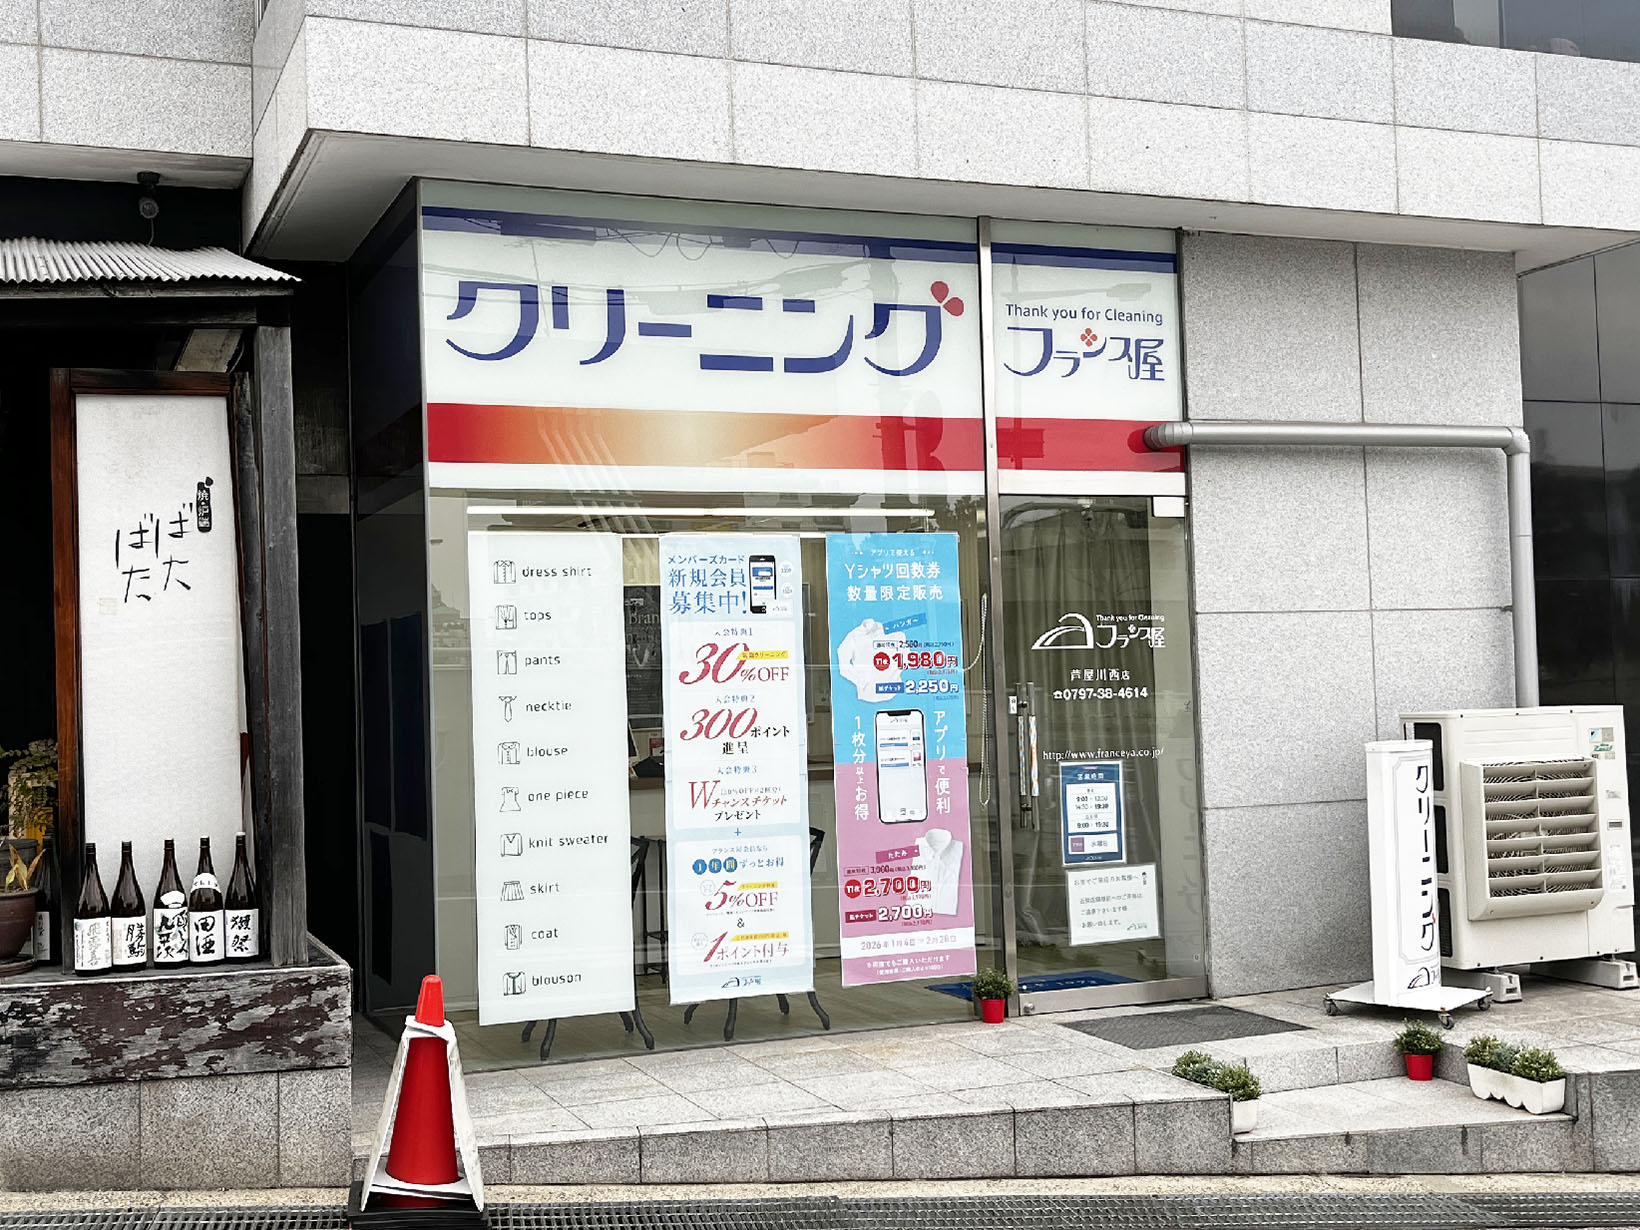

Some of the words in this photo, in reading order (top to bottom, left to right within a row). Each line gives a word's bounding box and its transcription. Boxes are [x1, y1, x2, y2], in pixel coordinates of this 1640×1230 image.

[1005, 304, 1048, 318] Thank
[1052, 308, 1077, 321] you
[1081, 307, 1100, 320] for
[1104, 308, 1163, 326] Cleaning
[446, 281, 965, 376] クリーニング
[1003, 327, 1165, 381] フランス屋
[668, 554, 745, 565] メンバーズカード
[522, 566, 558, 578] dress
[561, 565, 592, 578] shirt
[669, 567, 747, 588] 新規会員
[844, 561, 942, 580] Yシャツ回数券
[847, 584, 944, 602] 数量限定販売
[524, 610, 552, 622] tops
[892, 618, 919, 629] ハンガー
[1096, 614, 1115, 622] Thank
[1138, 614, 1165, 622] Cleaning
[1095, 624, 1166, 648] フランス屋
[524, 654, 561, 666] pants
[892, 651, 958, 670] 1,980円
[1070, 668, 1131, 682] 芦屋川西店
[904, 679, 960, 695] 2,250円
[1063, 687, 1149, 700] 0797-38-4614
[525, 700, 572, 712] necktie
[526, 746, 568, 757] blouse
[722, 741, 749, 755] 進呈
[1042, 746, 1165, 762] http://www.franceya.co.jp/
[851, 715, 870, 821] 1枚分以上お得
[933, 710, 951, 815] アプリで便利
[527, 790, 551, 802] one
[555, 788, 589, 802] piece
[714, 809, 761, 821] プレゼント
[528, 837, 553, 849] knit
[558, 834, 609, 847] sweater
[888, 850, 908, 860] たたみ
[1415, 765, 1436, 952] クリーニング
[529, 882, 560, 894] skirt
[863, 876, 932, 898] 2,700円
[878, 904, 934, 922] 2,700円
[194, 915, 216, 957] 田酒
[230, 914, 252, 952] 獺祭
[530, 928, 559, 940] coat
[531, 973, 582, 987] blouson
